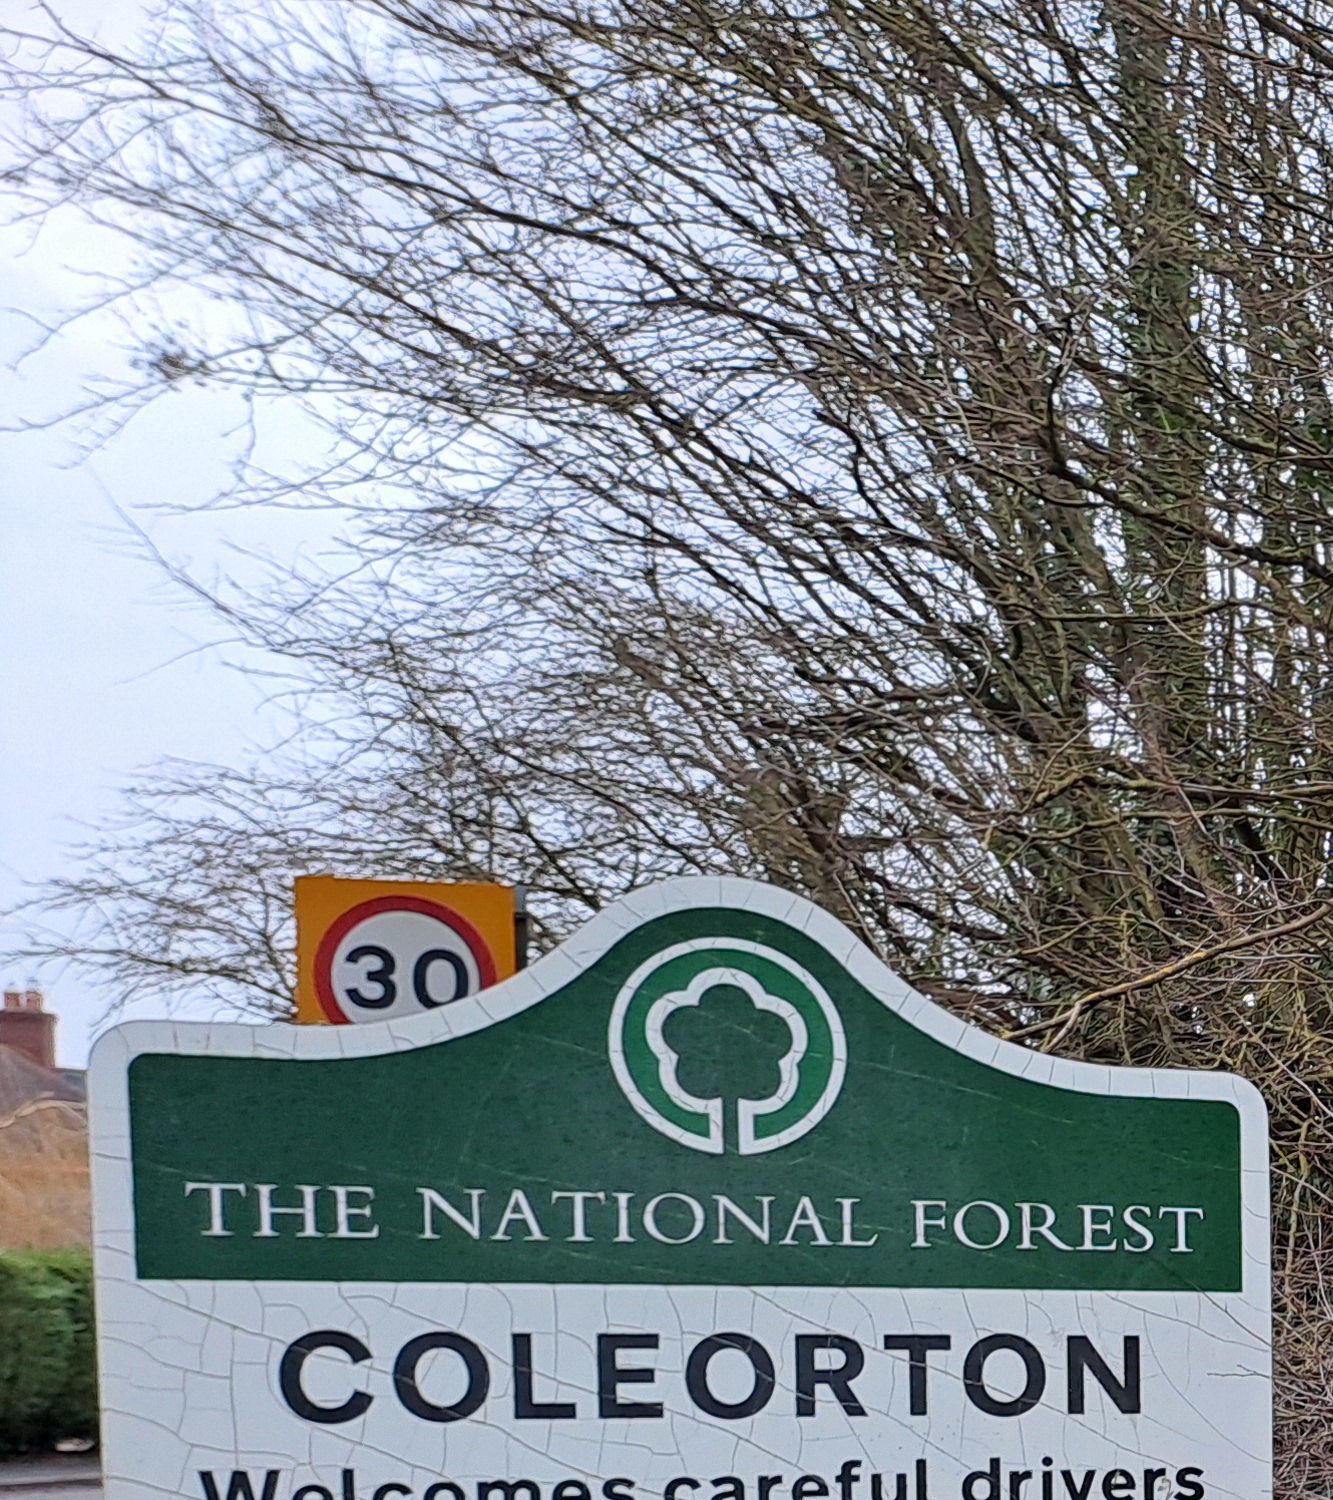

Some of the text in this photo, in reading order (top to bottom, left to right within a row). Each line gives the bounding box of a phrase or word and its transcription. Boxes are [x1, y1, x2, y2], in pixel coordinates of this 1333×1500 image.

[345, 945, 469, 1009] 30
[184, 1181, 1205, 1254] THE NATIONAL FOREST
[278, 1329, 1142, 1424] COLEORTON
